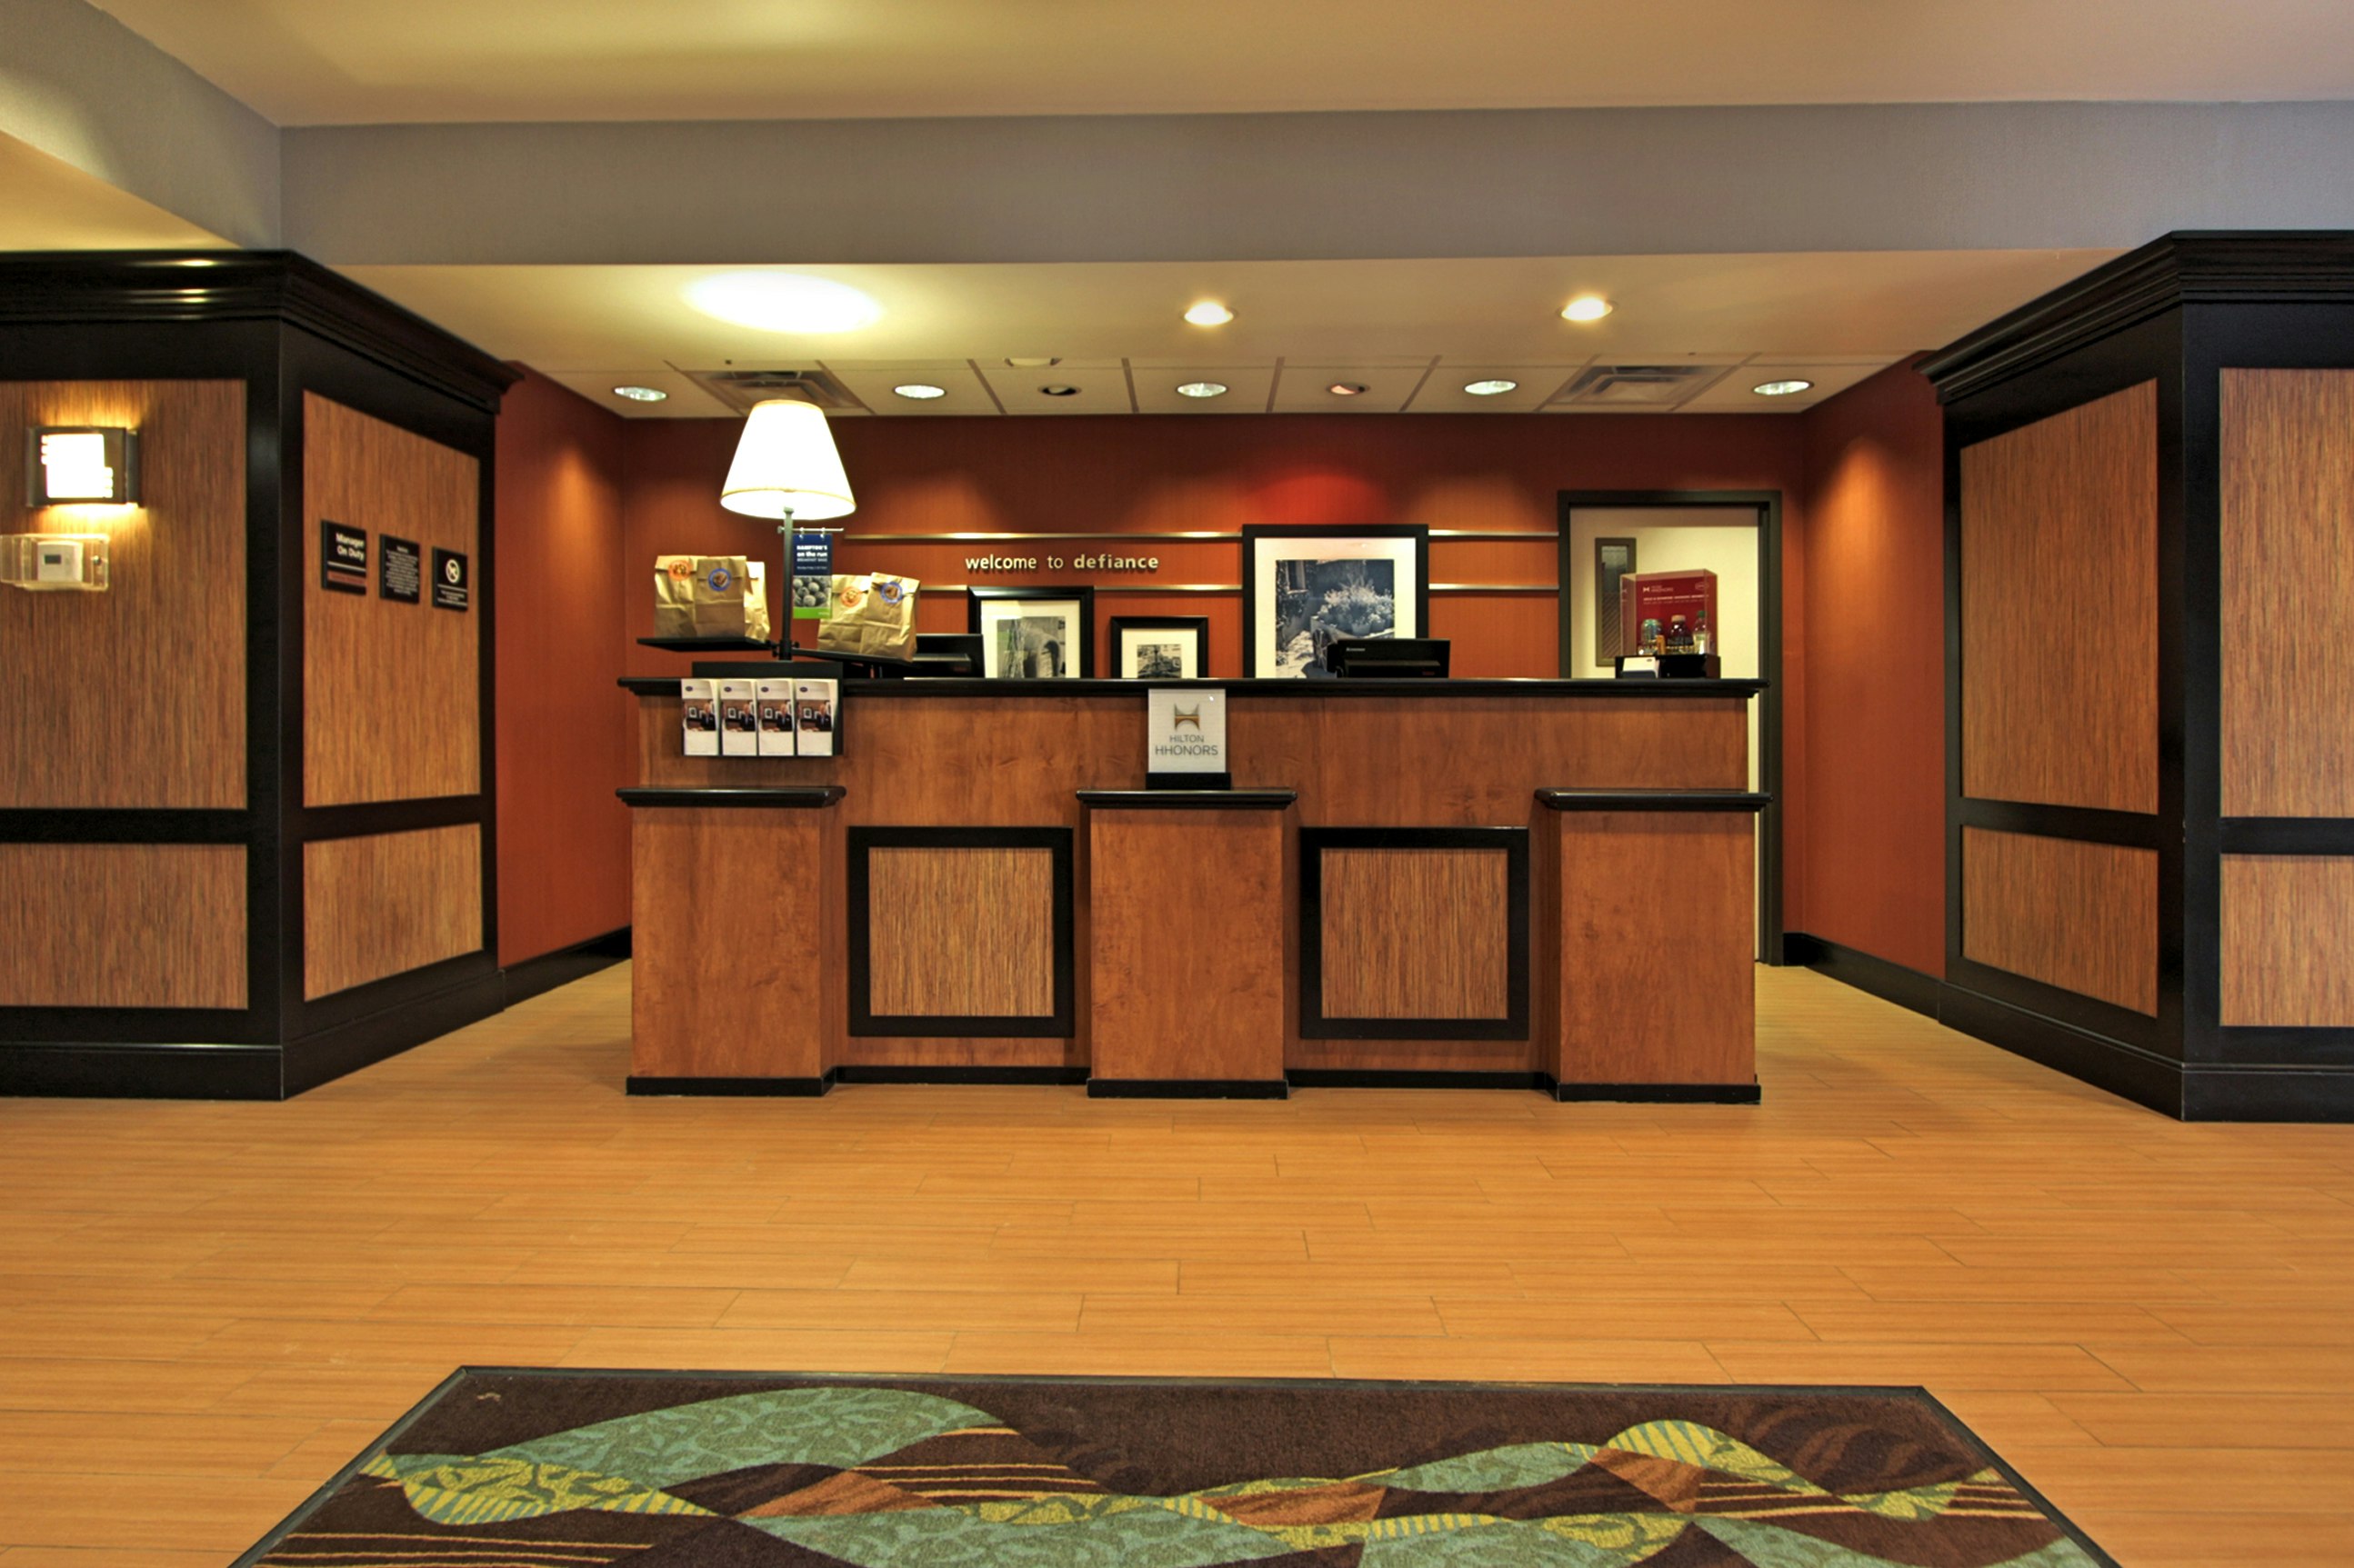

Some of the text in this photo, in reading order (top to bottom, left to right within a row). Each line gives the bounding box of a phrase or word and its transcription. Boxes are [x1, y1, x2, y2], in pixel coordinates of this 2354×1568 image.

[336, 545, 365, 562] On Duty
[966, 554, 1158, 569] welcome to defiance
[1169, 734, 1205, 743] HILTON
[1155, 745, 1218, 755] HHONORS
